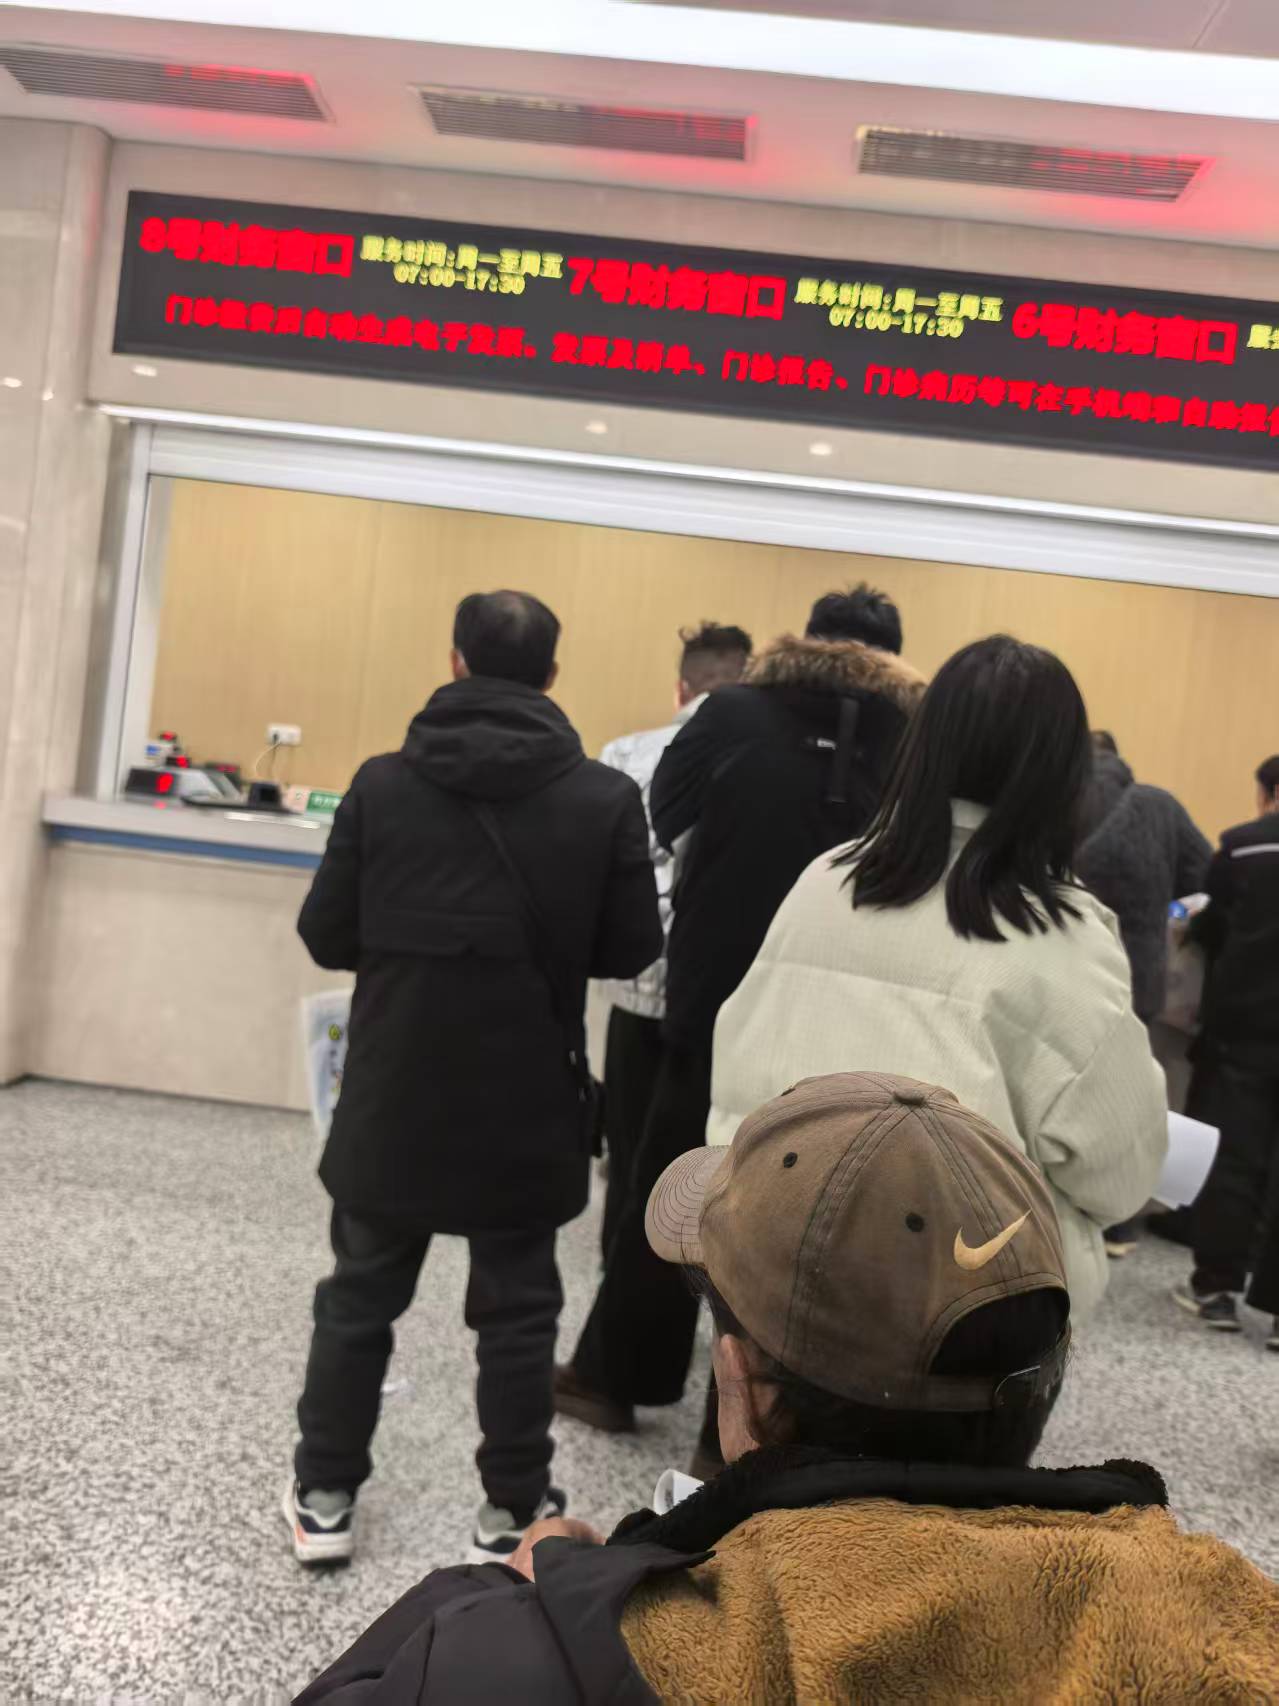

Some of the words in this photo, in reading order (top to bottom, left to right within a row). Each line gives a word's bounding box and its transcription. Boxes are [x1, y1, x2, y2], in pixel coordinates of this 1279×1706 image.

[393, 261, 526, 295] 07:00-17:30
[567, 257, 787, 321] 7号财务窗口
[828, 305, 965, 338] 07:00-17:30
[1012, 302, 1238, 365] 6号财务窗口
